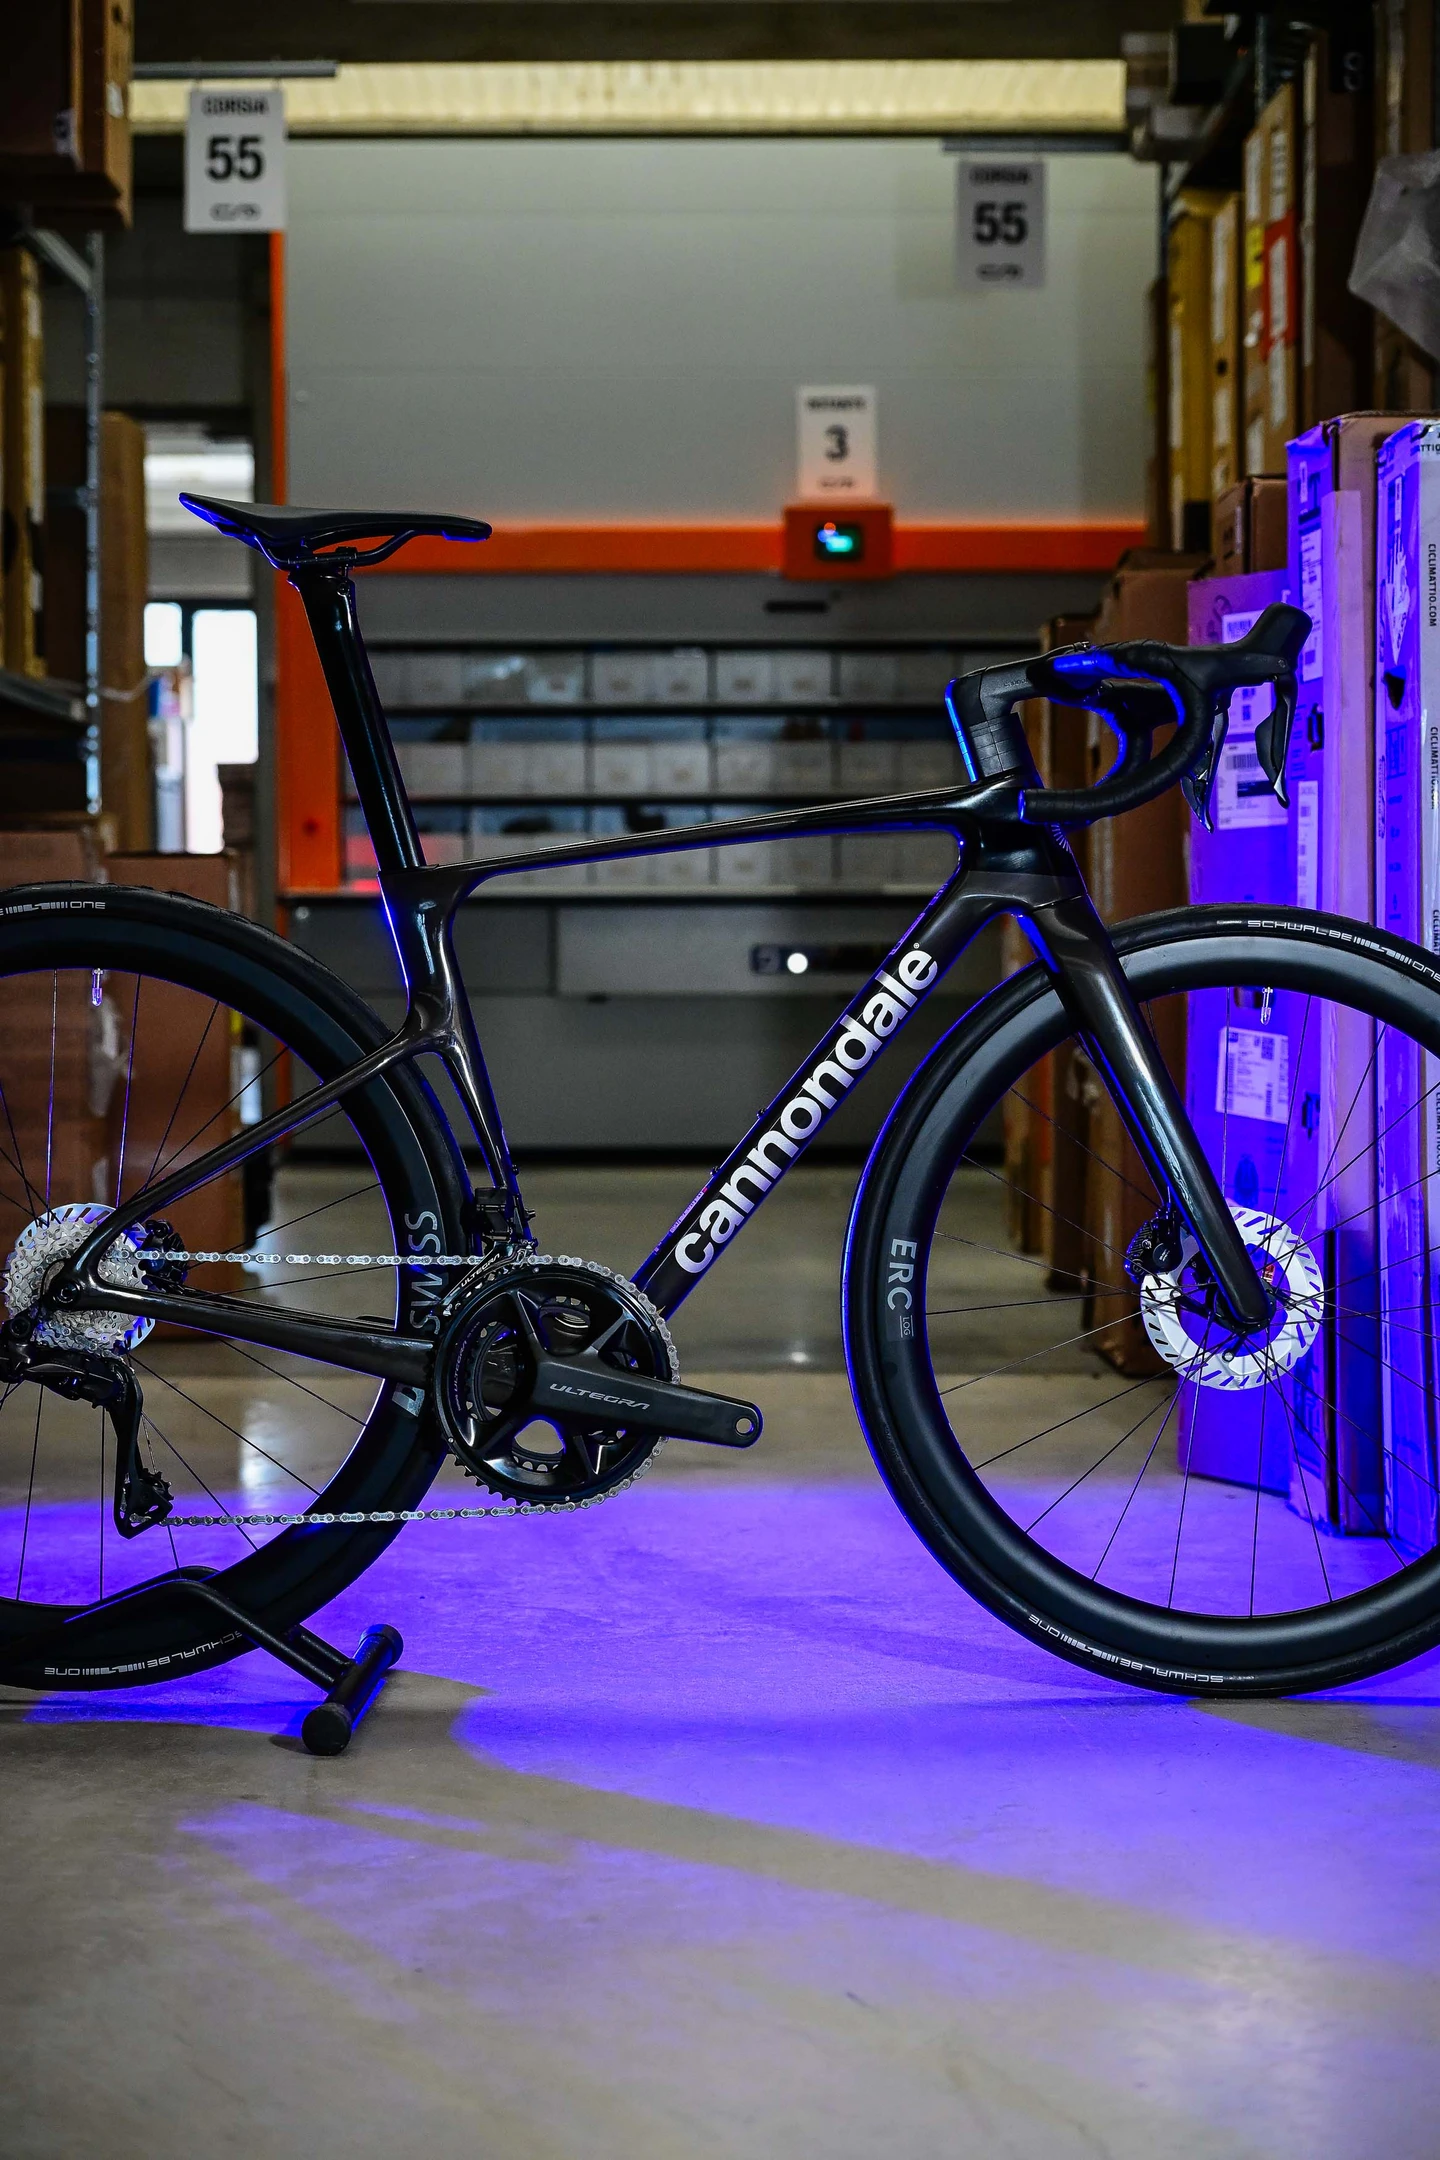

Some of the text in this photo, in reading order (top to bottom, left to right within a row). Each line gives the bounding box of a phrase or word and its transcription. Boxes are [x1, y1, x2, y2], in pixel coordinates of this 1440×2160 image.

[207, 136, 264, 181] 55
[975, 202, 1028, 245] 55
[824, 424, 849, 462] 3
[1428, 543, 1437, 627] CICLIMATTIO.COM
[69, 901, 106, 911] ONE
[1247, 919, 1352, 942] SCHWALBE
[674, 949, 938, 1274] cannondale
[404, 1210, 443, 1335] SWSS
[461, 1253, 500, 1288] ULTEGRA
[887, 1238, 918, 1311] ERC
[549, 1383, 651, 1411] ULTEGRA
[44, 1630, 243, 1676] SCHWALBE ONE
[1028, 1613, 1225, 1684] SCHWALBE ONE
